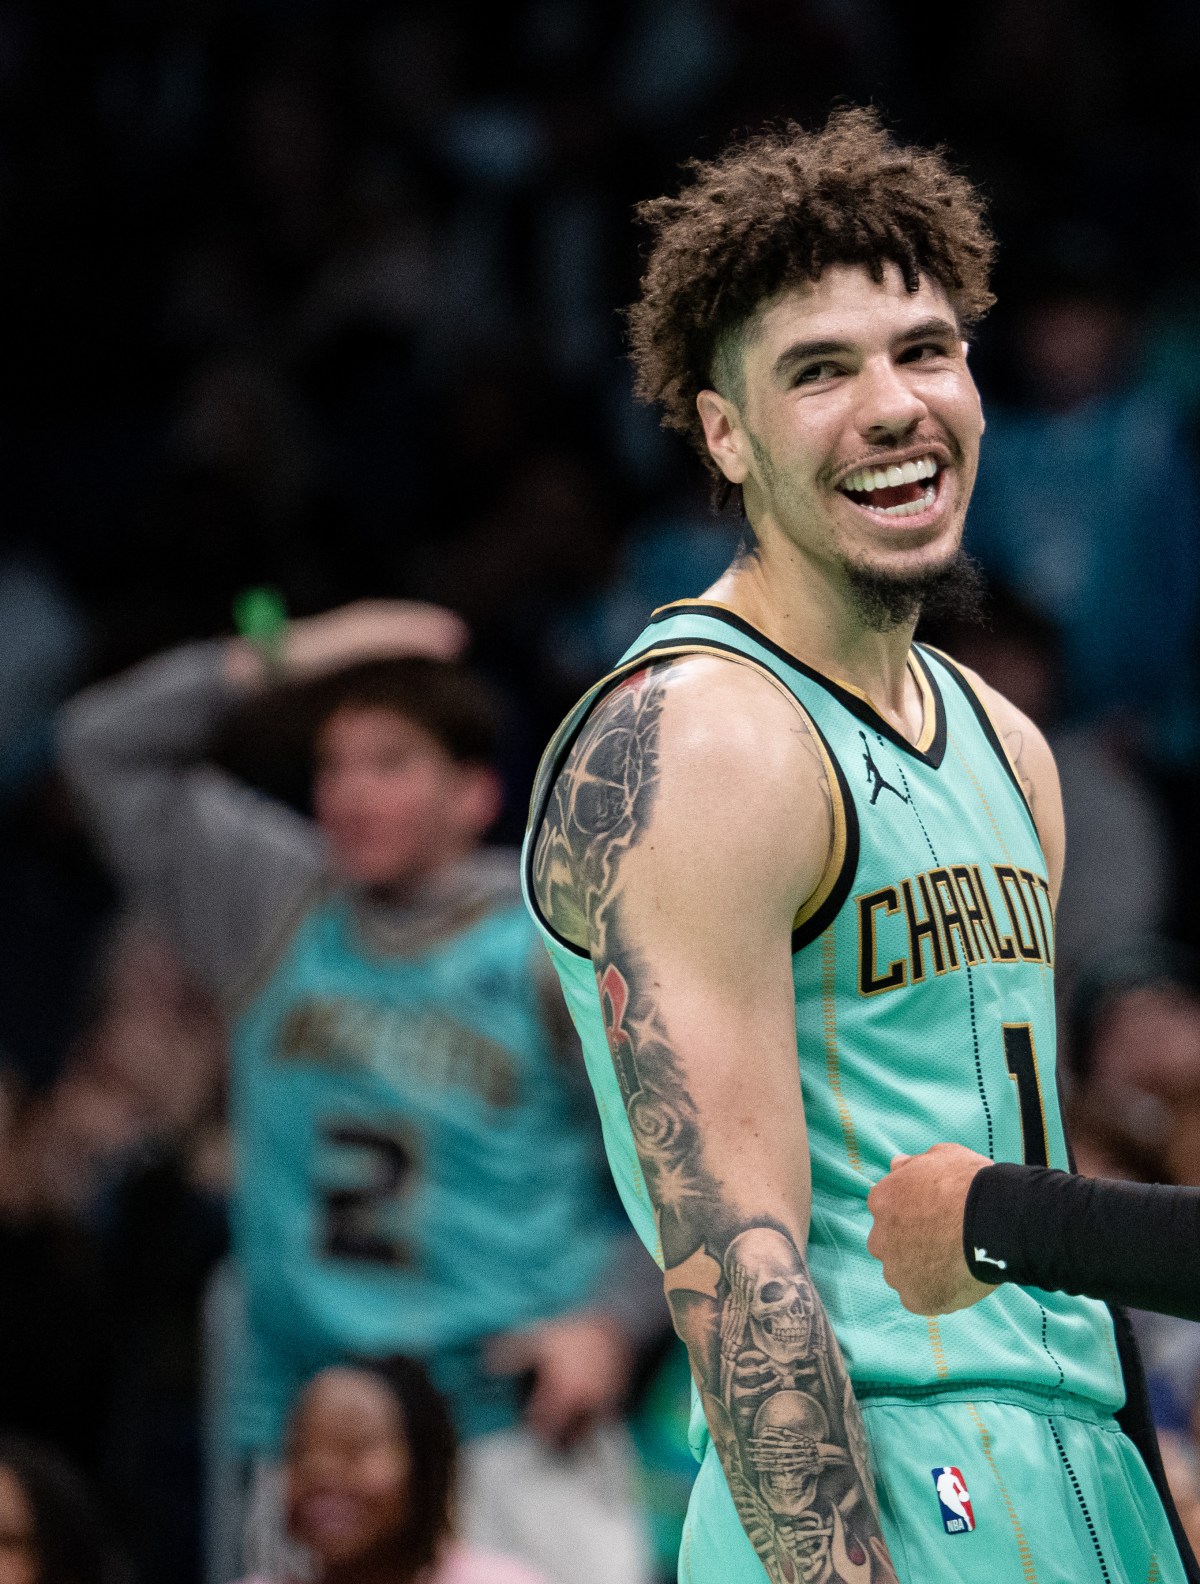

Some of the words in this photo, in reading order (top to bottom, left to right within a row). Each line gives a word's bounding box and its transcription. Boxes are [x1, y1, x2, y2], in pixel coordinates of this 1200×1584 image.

[1002, 1023, 1049, 1168] 1
[315, 1115, 418, 1266] 2
[946, 1518, 965, 1532] NBA
